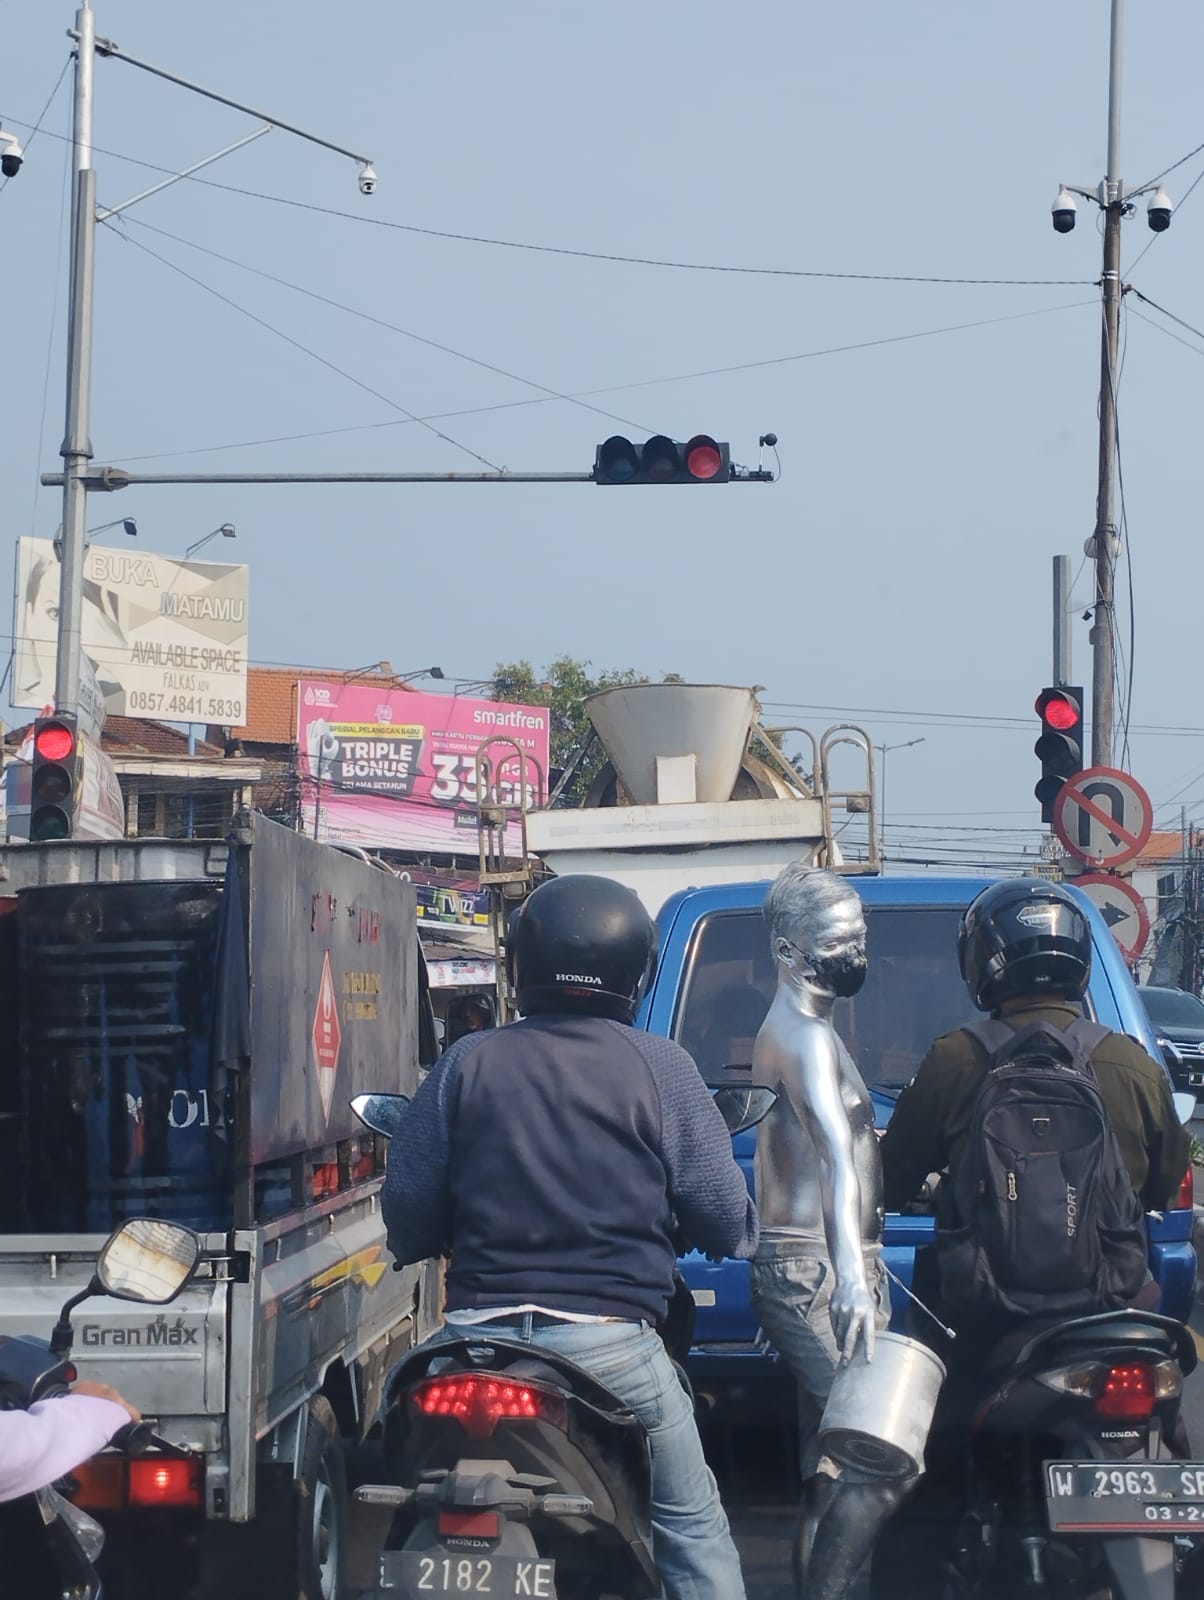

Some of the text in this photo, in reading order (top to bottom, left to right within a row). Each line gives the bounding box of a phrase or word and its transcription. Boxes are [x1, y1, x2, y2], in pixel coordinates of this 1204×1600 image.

[91, 554, 159, 588] BUKA
[160, 591, 245, 622] MATAMU
[130, 640, 241, 673] AVAILABLE SPACE
[163, 672, 196, 691] FALKAS
[130, 690, 242, 719] 0857.4841.5839
[473, 710, 544, 730] smartfren
[341, 741, 413, 761] TRIPLE
[341, 760, 409, 778] BONUS
[430, 754, 487, 803] 33
[555, 973, 602, 985] HONDA
[1067, 1182, 1077, 1238] SPORT
[83, 1322, 199, 1346] Gran Max
[1101, 1430, 1140, 1438] HONDA
[1055, 1471, 1072, 1496] W
[1094, 1471, 1157, 1496] 2963
[446, 1538, 491, 1548] HONDA
[418, 1557, 493, 1592] 2182
[515, 1562, 552, 1597] KE
